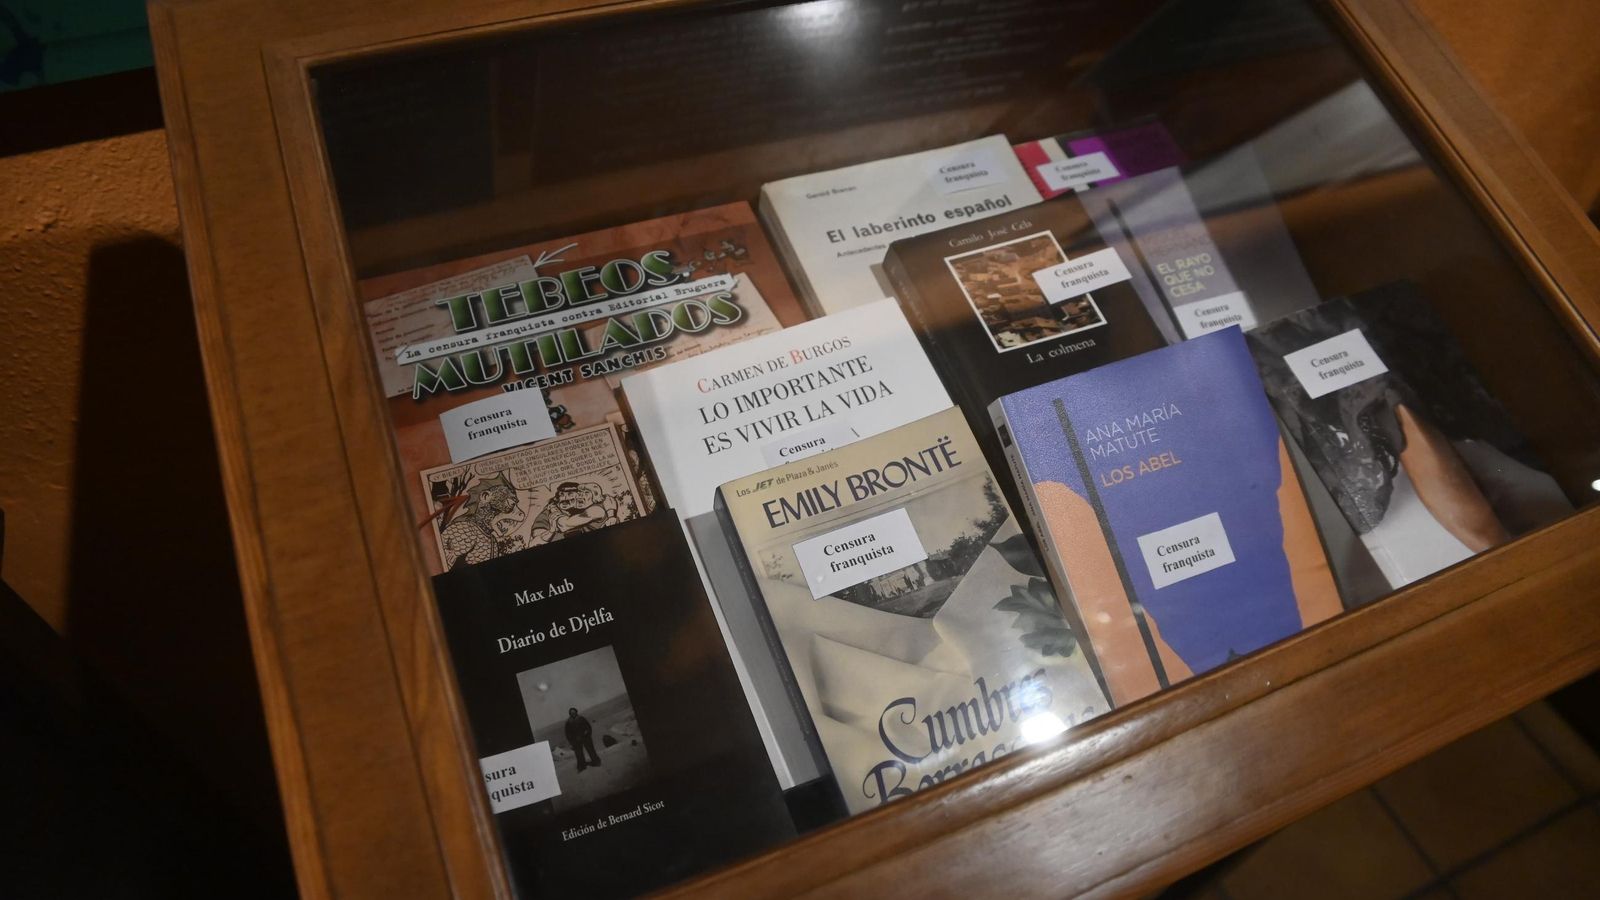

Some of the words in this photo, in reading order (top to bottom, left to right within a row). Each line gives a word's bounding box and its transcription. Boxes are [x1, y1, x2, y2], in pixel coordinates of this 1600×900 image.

[939, 161, 975, 174] Censura
[826, 230, 846, 244] El
[852, 212, 936, 239] laberinto
[943, 194, 1013, 220] español
[948, 233, 984, 249] Camilo
[988, 226, 1009, 241] José
[1054, 260, 1094, 278] Censura
[1156, 263, 1175, 275] EL
[1176, 252, 1212, 270] RAYO
[1163, 271, 1192, 286] QUE
[1193, 265, 1216, 279] NO
[435, 250, 681, 333] TEBEOS
[1061, 268, 1110, 289] franquista
[1169, 282, 1206, 298] CESA
[405, 350, 422, 359] La
[428, 336, 479, 353] censura
[485, 318, 556, 341] franquista
[561, 308, 603, 322] contra
[607, 292, 668, 311] Editorial
[674, 279, 727, 296] Bruguera
[1194, 303, 1230, 318] Censura
[413, 292, 742, 400] MUTILADOS
[1026, 352, 1044, 364] La
[1048, 338, 1096, 358] colmena
[1310, 350, 1349, 368] Censura
[503, 369, 573, 392] VICENT
[580, 346, 666, 378] SANCHIS
[697, 363, 765, 394] CARMEN
[765, 356, 789, 373] DE
[789, 336, 852, 365] BURGOS
[1319, 359, 1365, 380] franquista
[698, 402, 730, 425] LO
[733, 355, 873, 414] IMPORTANTE
[464, 408, 512, 428] Censura
[467, 419, 528, 440] franquista
[702, 431, 733, 456] ES
[734, 410, 802, 444] VIVIR
[803, 400, 836, 423] LA
[836, 380, 894, 410] VIDA
[1085, 425, 1125, 445] ANA
[1126, 403, 1183, 432] MARÍA
[779, 436, 826, 458] Censura
[1089, 427, 1161, 461] MATUTE
[736, 487, 752, 498] Los
[752, 478, 776, 493] JET
[776, 475, 786, 485] de
[786, 468, 808, 482] Plaza
[808, 467, 815, 476] &
[815, 460, 839, 473] Janés
[762, 480, 842, 529] EMILY
[846, 435, 962, 501] BRONTË
[1100, 465, 1135, 488] LOS
[1139, 450, 1183, 476] ABEL
[823, 532, 876, 556] Censura
[1156, 535, 1201, 557] Censura
[829, 544, 895, 572] franquista
[1162, 547, 1216, 573] franquista
[514, 590, 545, 607] Max
[547, 578, 575, 598] Aub
[497, 628, 546, 654] Diario
[549, 621, 567, 639] de
[568, 607, 614, 635] Djelfa
[485, 764, 517, 783] sura
[491, 778, 535, 803] quista
[562, 823, 596, 841] Edición
[596, 819, 607, 829] de
[608, 806, 643, 826] Bernard
[643, 800, 665, 815] Sicot
